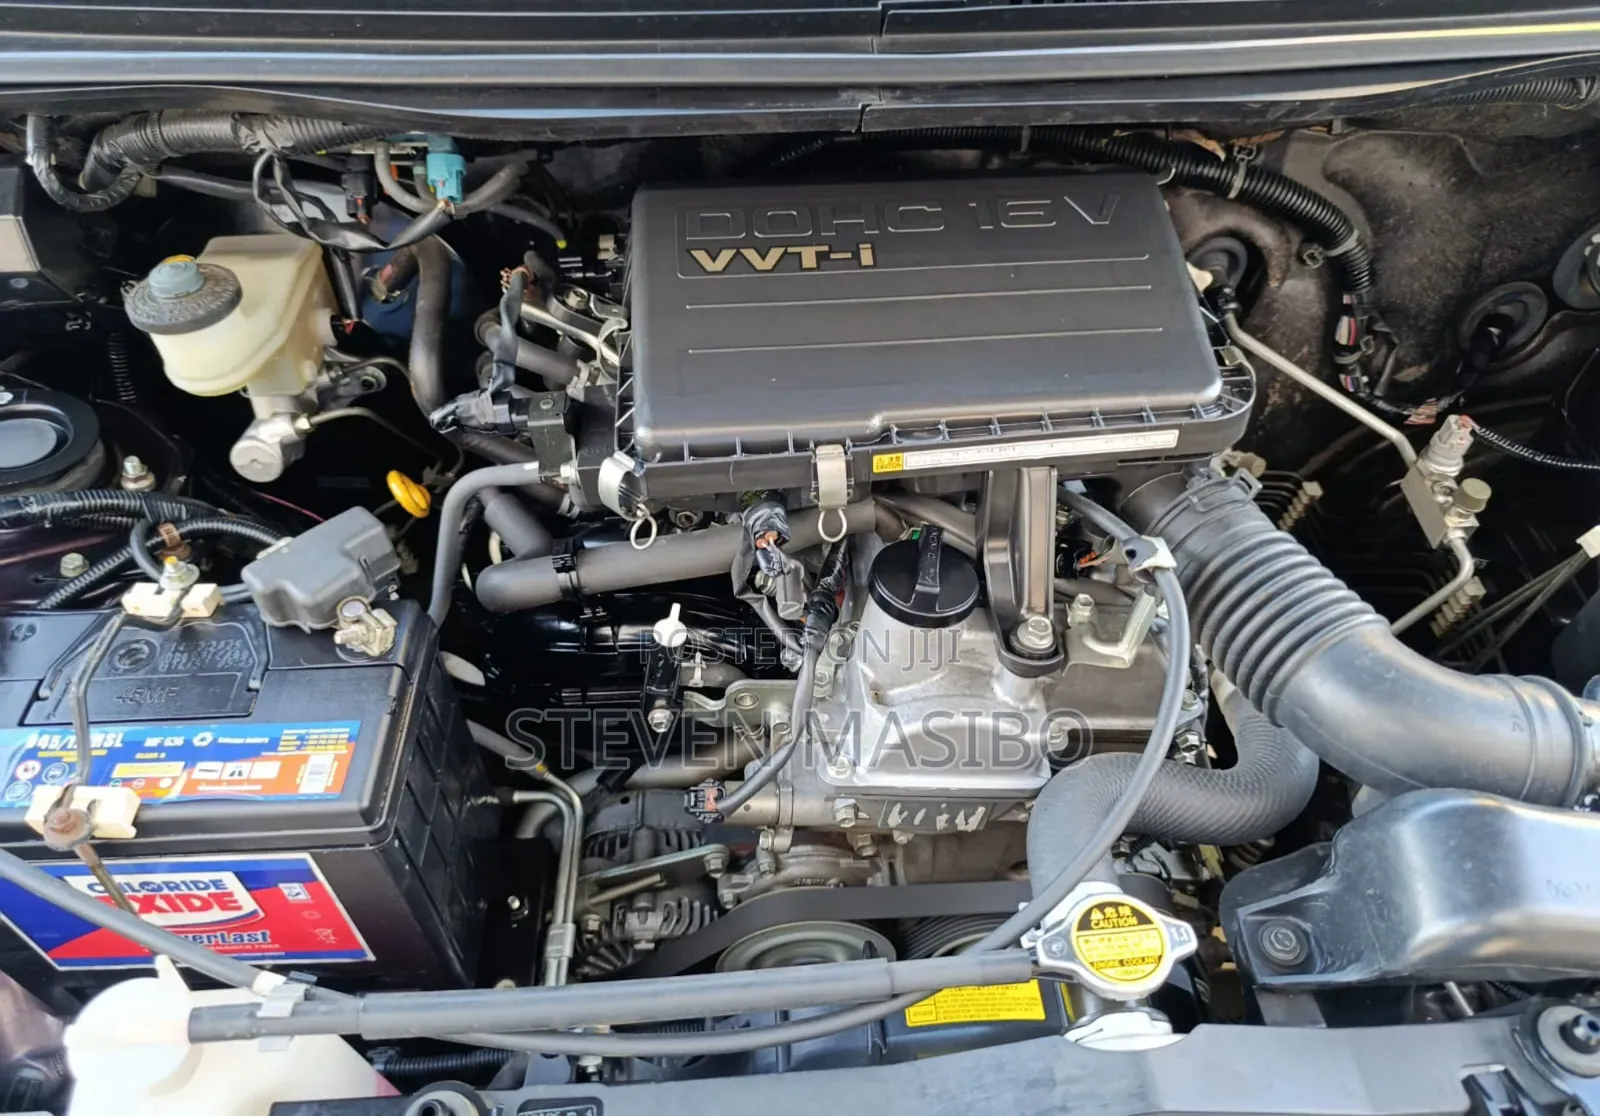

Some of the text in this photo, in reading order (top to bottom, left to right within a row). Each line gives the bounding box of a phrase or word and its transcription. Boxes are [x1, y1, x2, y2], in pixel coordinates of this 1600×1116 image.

[686, 195, 1120, 240] DOHC 16V
[688, 242, 875, 273] VVT-i
[1091, 916, 1138, 929] CAUTION
[1122, 956, 1159, 967] COOLANT
